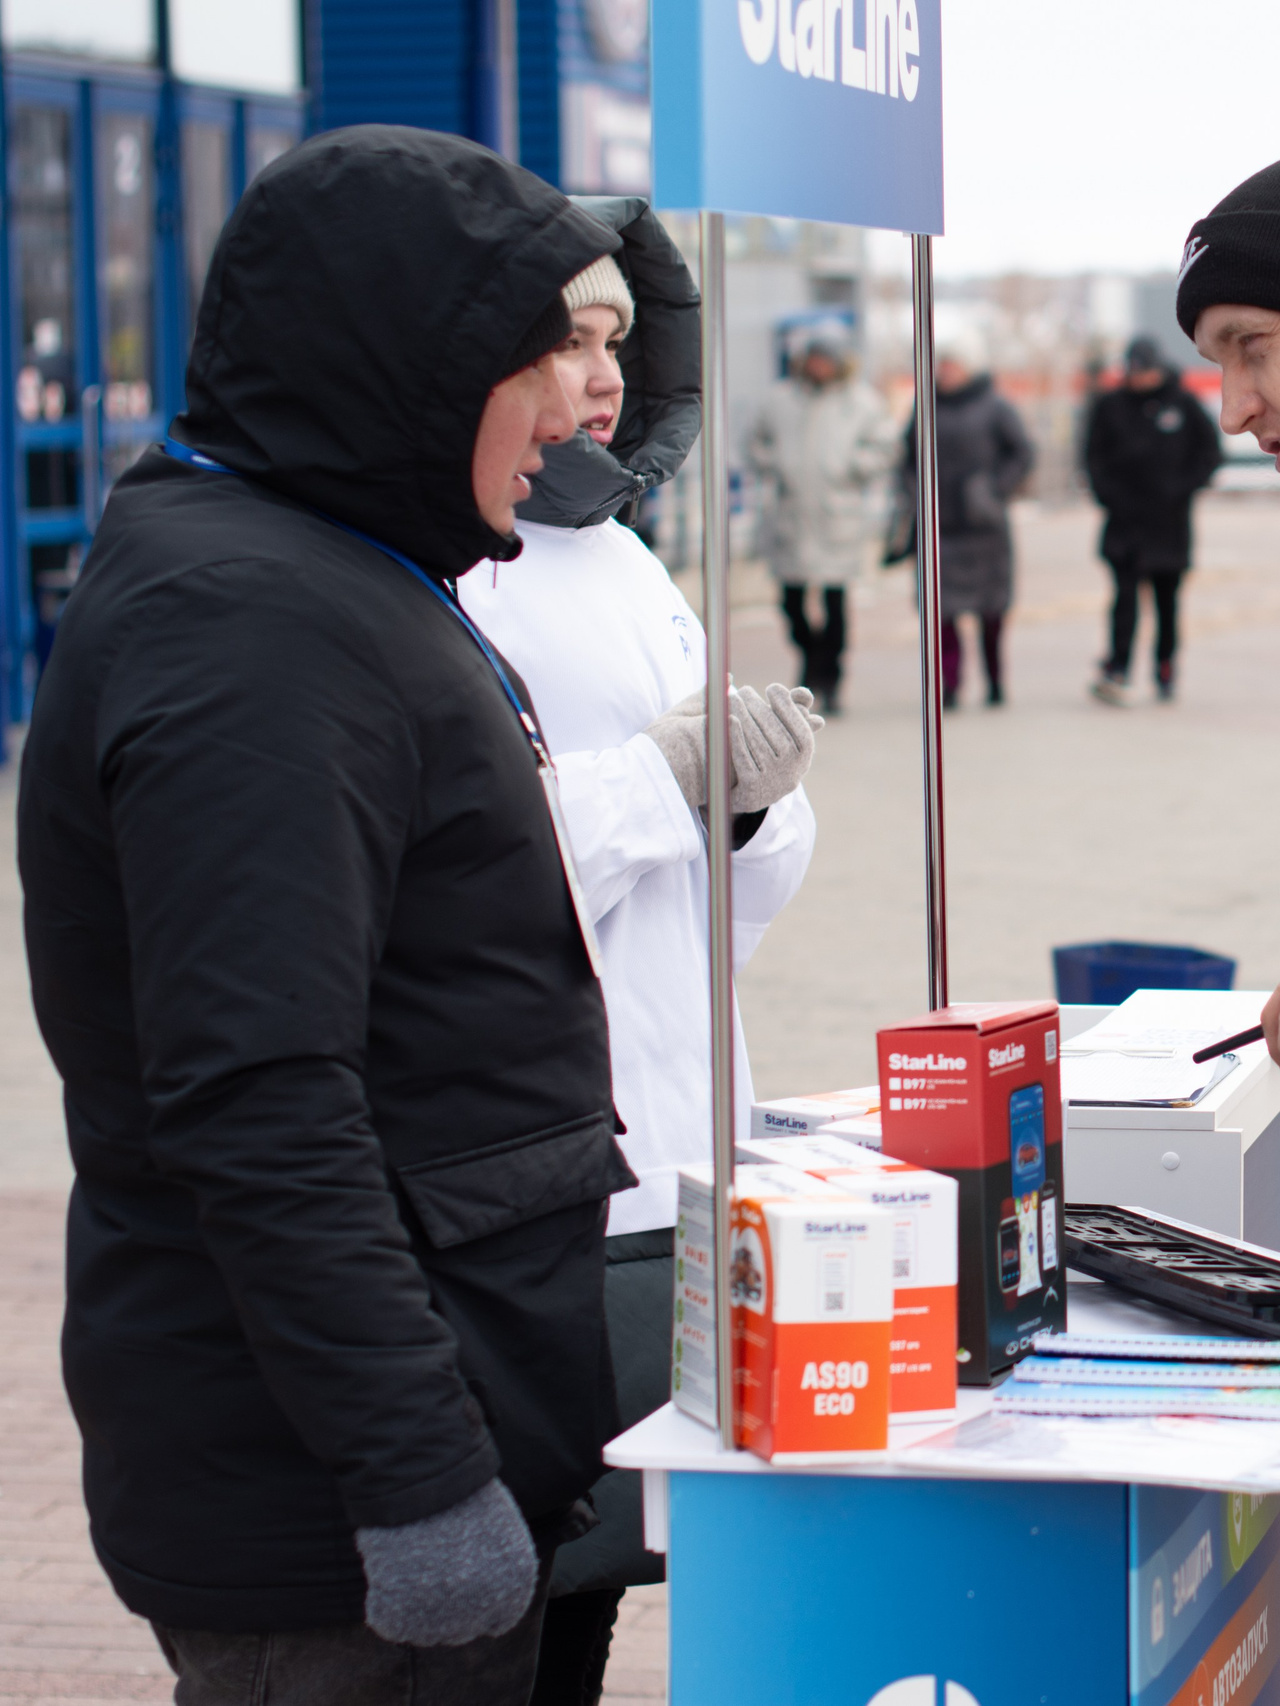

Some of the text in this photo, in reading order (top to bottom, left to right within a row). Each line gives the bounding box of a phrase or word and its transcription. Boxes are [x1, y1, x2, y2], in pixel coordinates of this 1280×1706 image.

[888, 1053, 967, 1070] StarLine
[988, 1043, 1025, 1068] StarLine
[903, 1078, 927, 1090] B97
[903, 1099, 927, 1110] B97
[764, 1113, 808, 1130] StarLine
[872, 1191, 931, 1204] StarLine
[805, 1221, 867, 1234] StarLine
[801, 1361, 868, 1390] AS90
[814, 1392, 855, 1416] ECO
[1172, 1529, 1213, 1617] ЗАЩИТА
[1212, 1604, 1269, 1706] АВТОЗАПУСК
